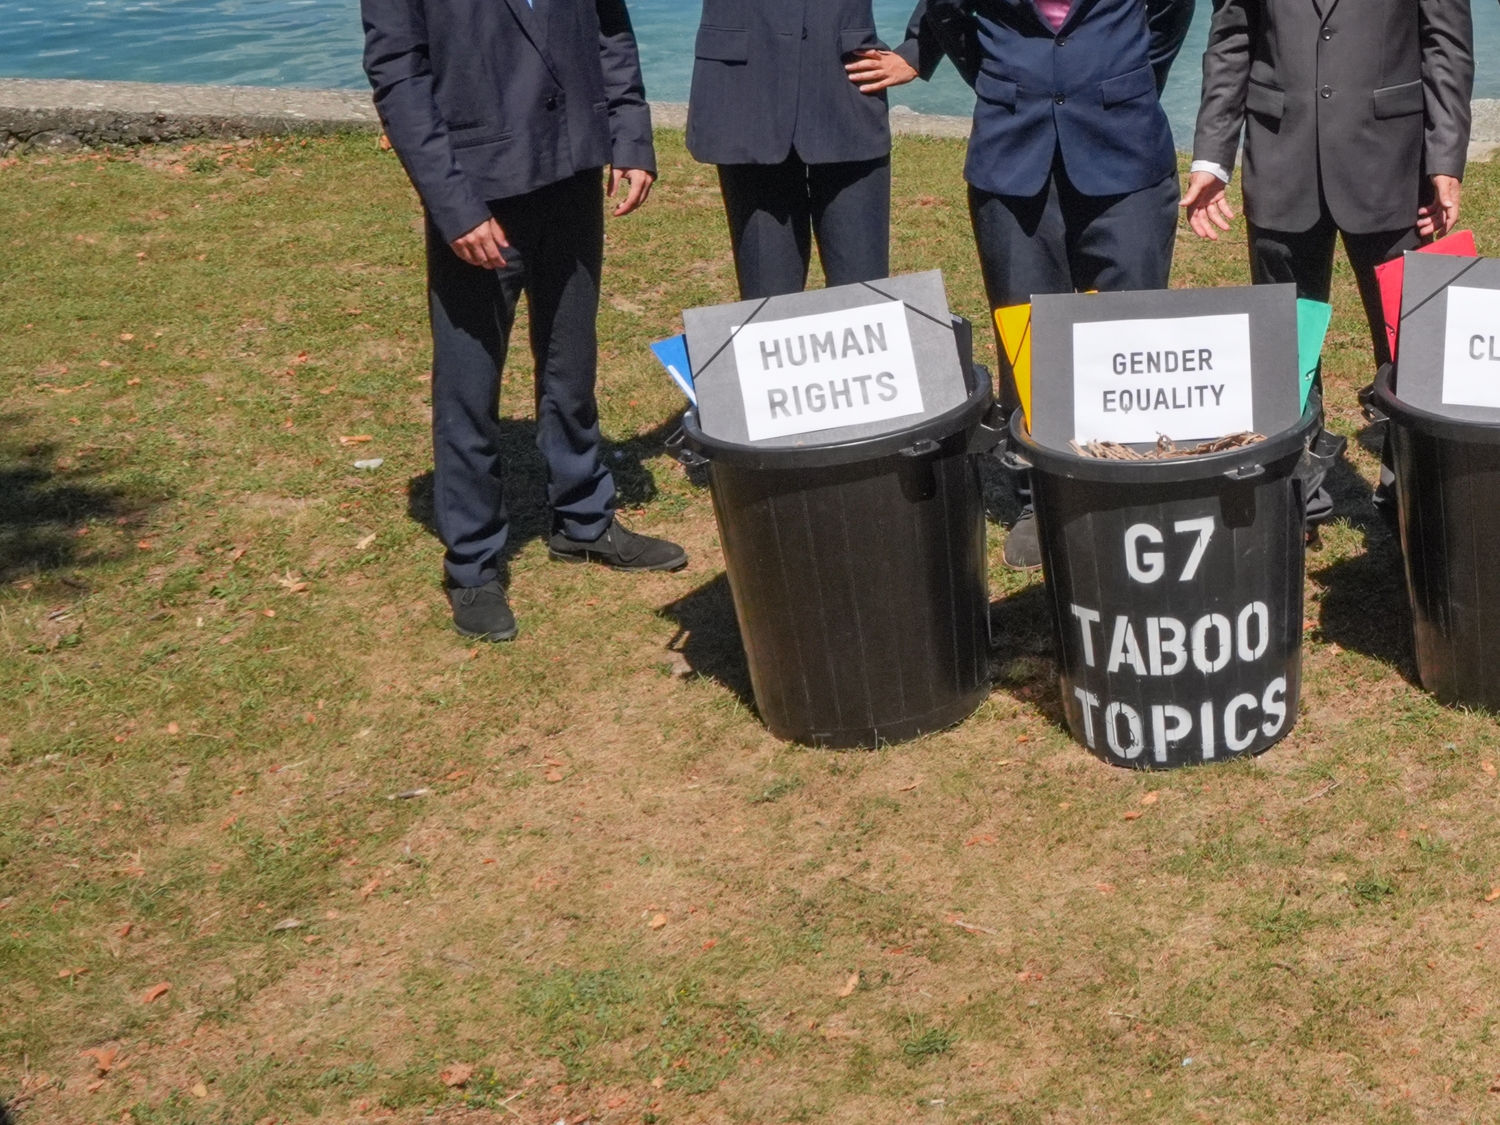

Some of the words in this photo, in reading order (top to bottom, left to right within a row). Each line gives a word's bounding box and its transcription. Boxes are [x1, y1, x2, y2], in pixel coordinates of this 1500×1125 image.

[759, 322, 888, 371] HUMAN
[1112, 349, 1214, 376] GENDER
[767, 372, 899, 420] RIGHTS
[1102, 384, 1225, 413] EQUALITY
[1124, 516, 1216, 584] G7
[1070, 601, 1269, 676] TABOO
[1074, 677, 1287, 762] TOPICS
